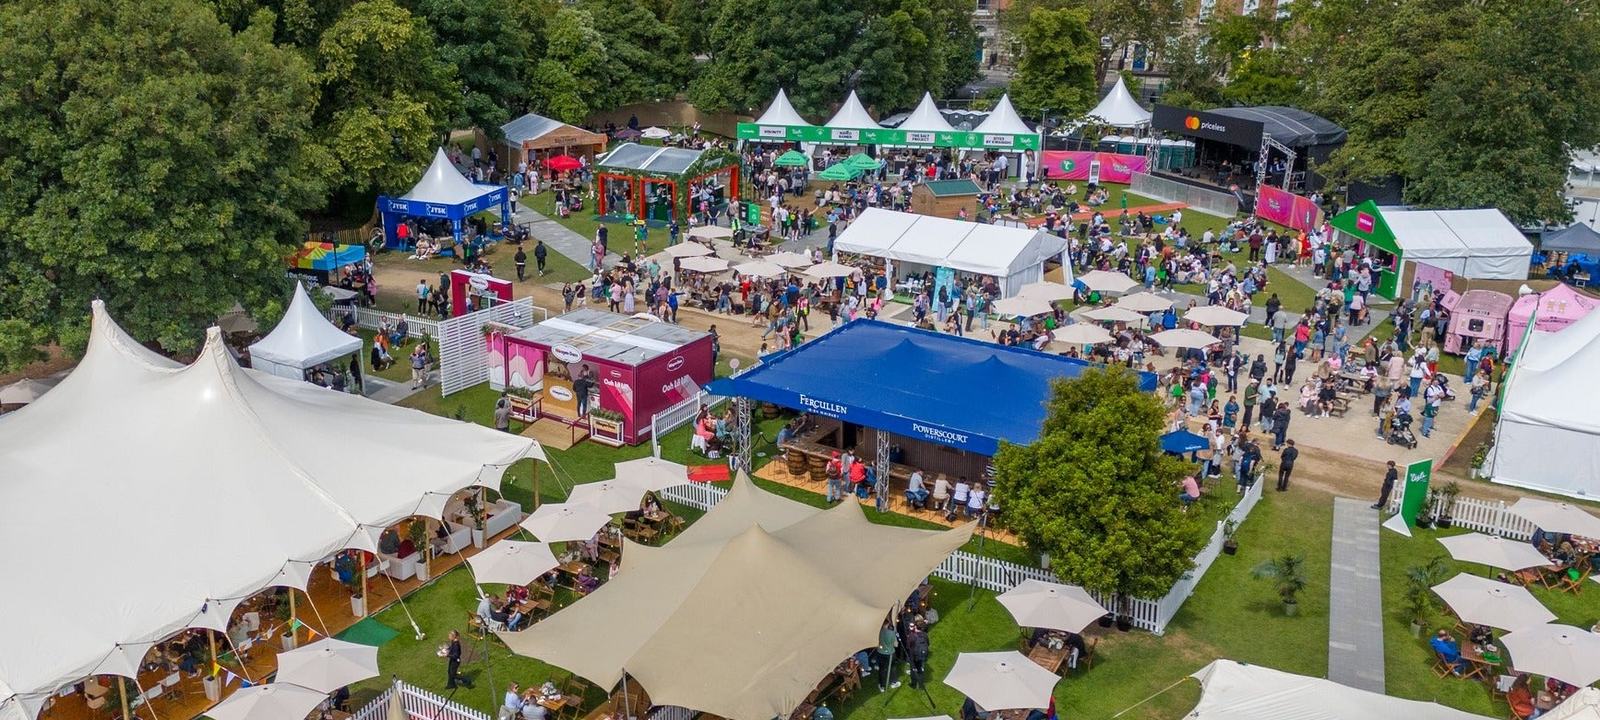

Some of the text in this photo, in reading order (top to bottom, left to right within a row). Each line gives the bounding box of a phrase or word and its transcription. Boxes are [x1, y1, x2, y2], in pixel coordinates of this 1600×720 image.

[1201, 122, 1225, 132] priceless
[392, 201, 408, 211] JYSK
[430, 206, 446, 215] JYSK
[467, 202, 478, 212] JYSK
[800, 394, 848, 415] FERCULLEN
[912, 423, 968, 443] POWERSCOURT
